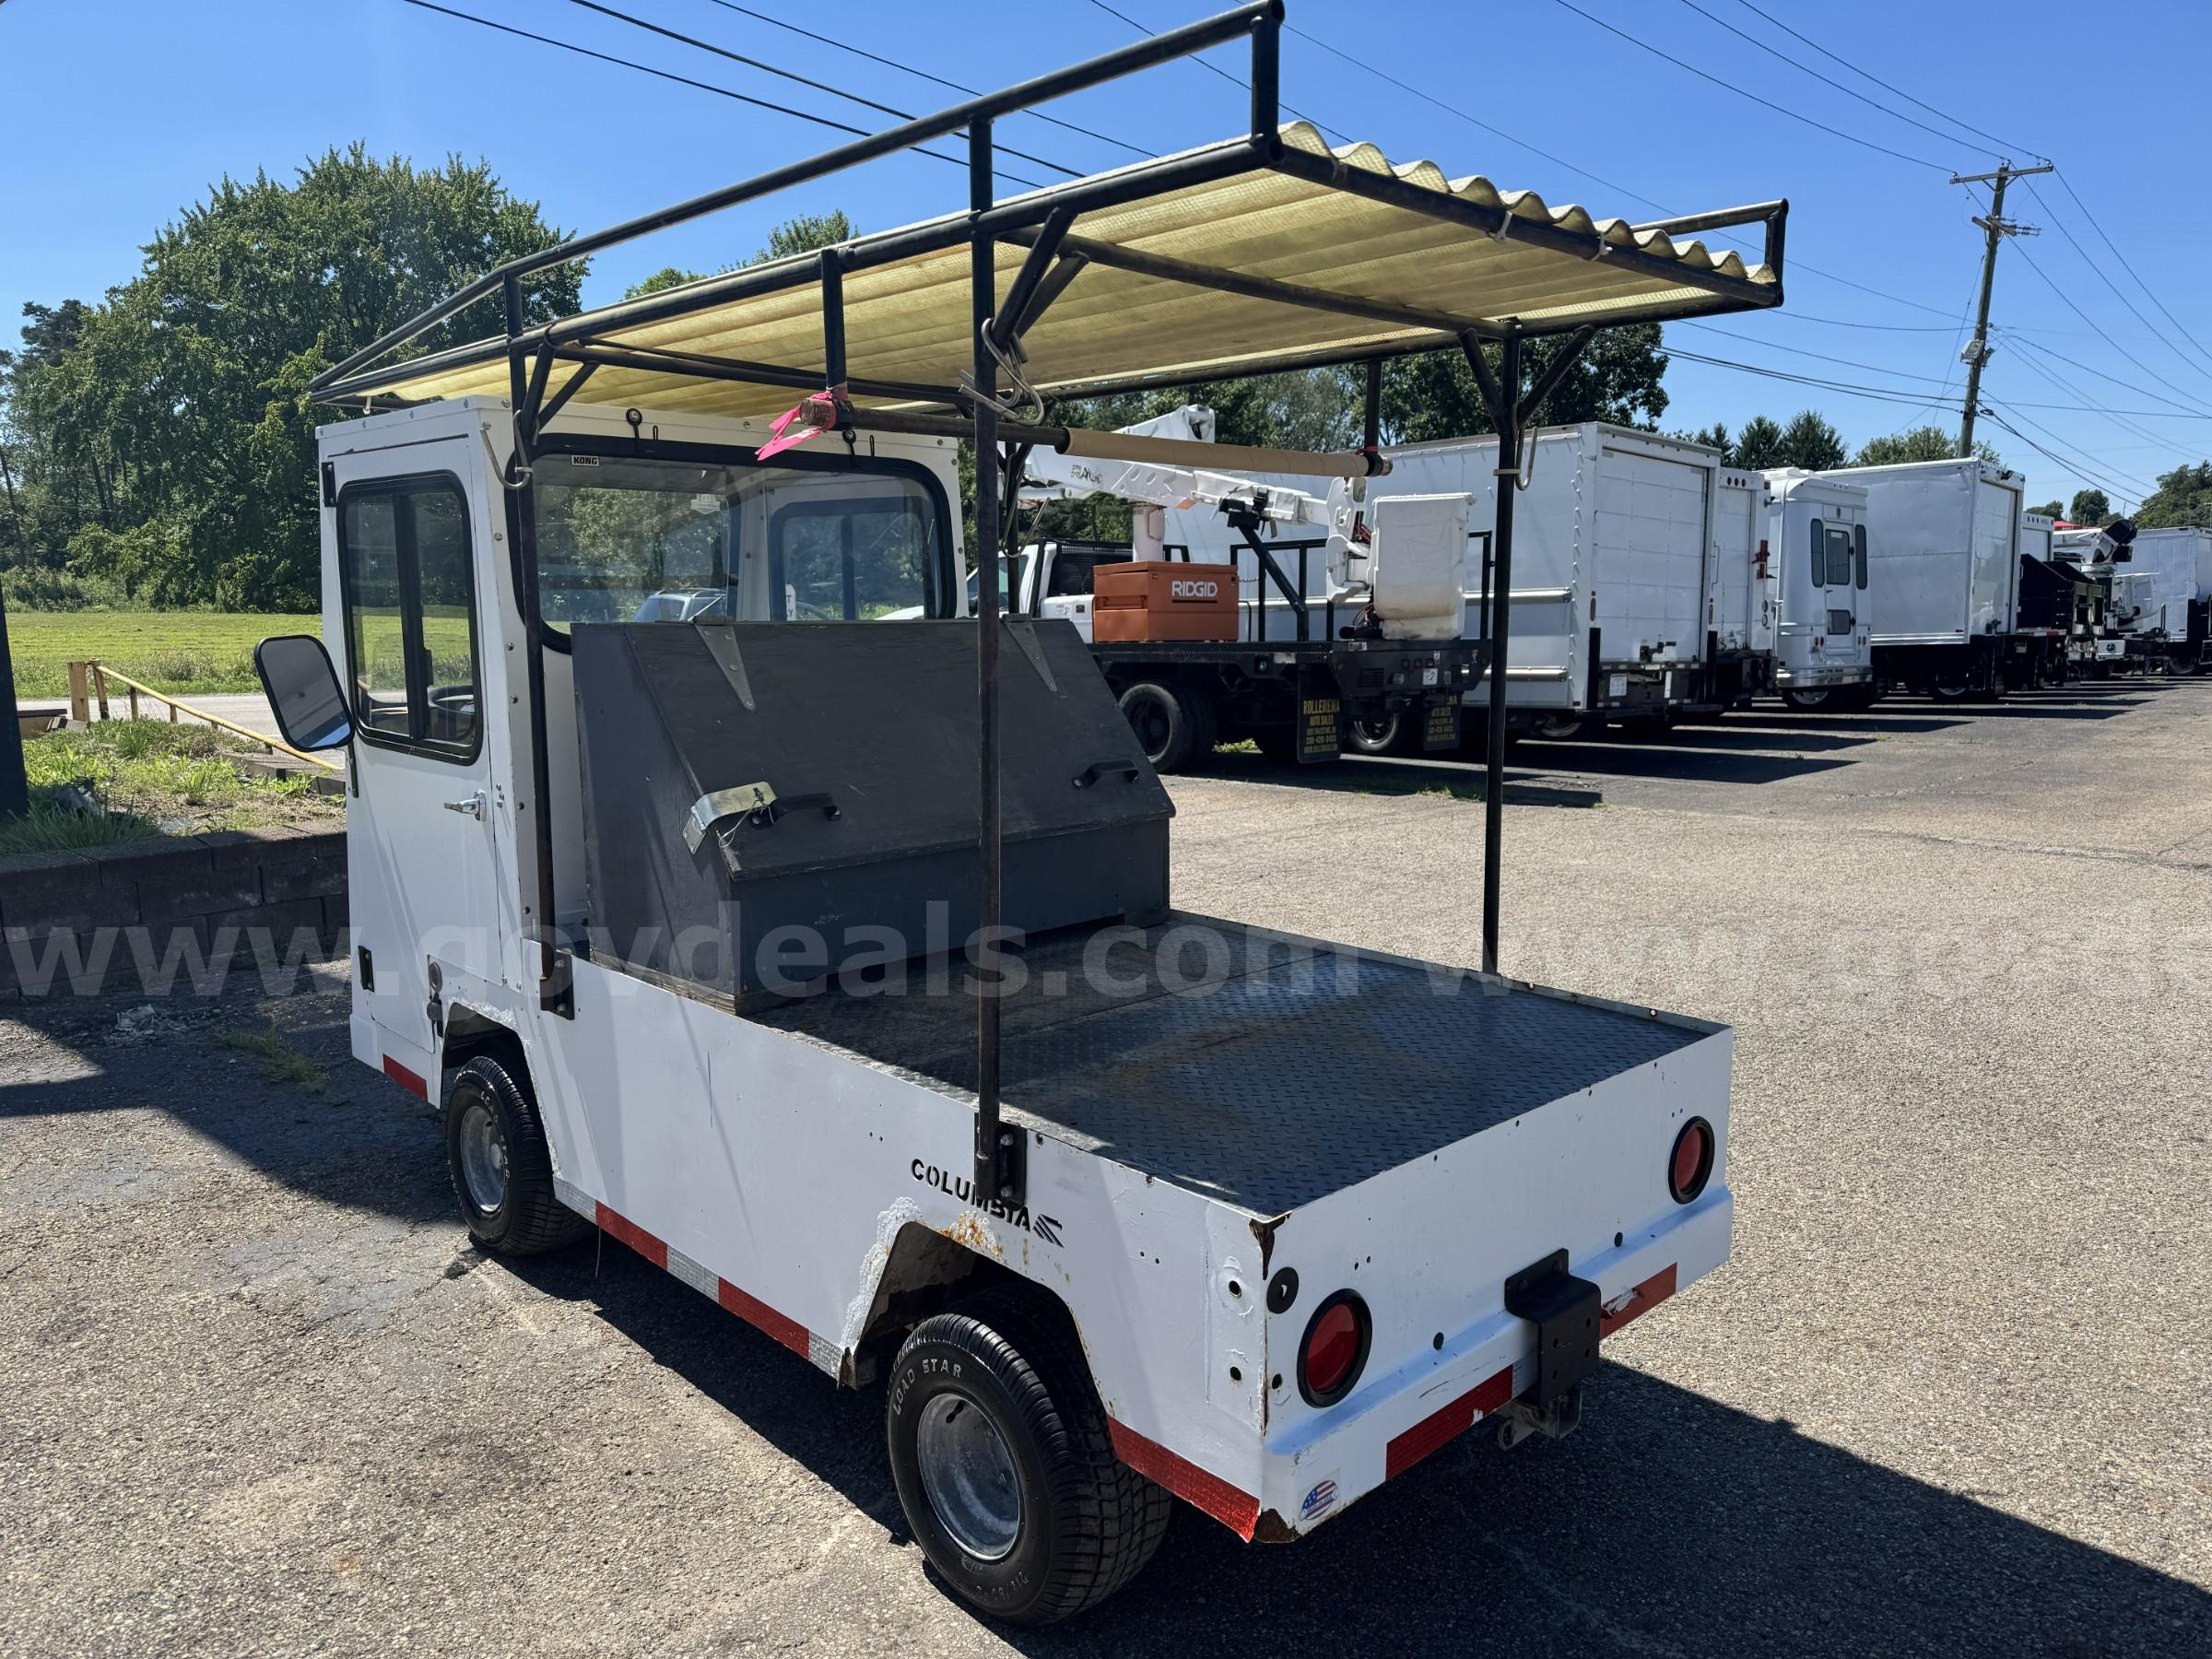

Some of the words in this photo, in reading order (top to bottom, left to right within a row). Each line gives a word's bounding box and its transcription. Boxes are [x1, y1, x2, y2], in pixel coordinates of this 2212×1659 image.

[573, 456, 598, 465] KONG
[1171, 581, 1218, 597] RIDGID
[893, 1368, 915, 1416] LOAD
[922, 1358, 961, 1378] STAR
